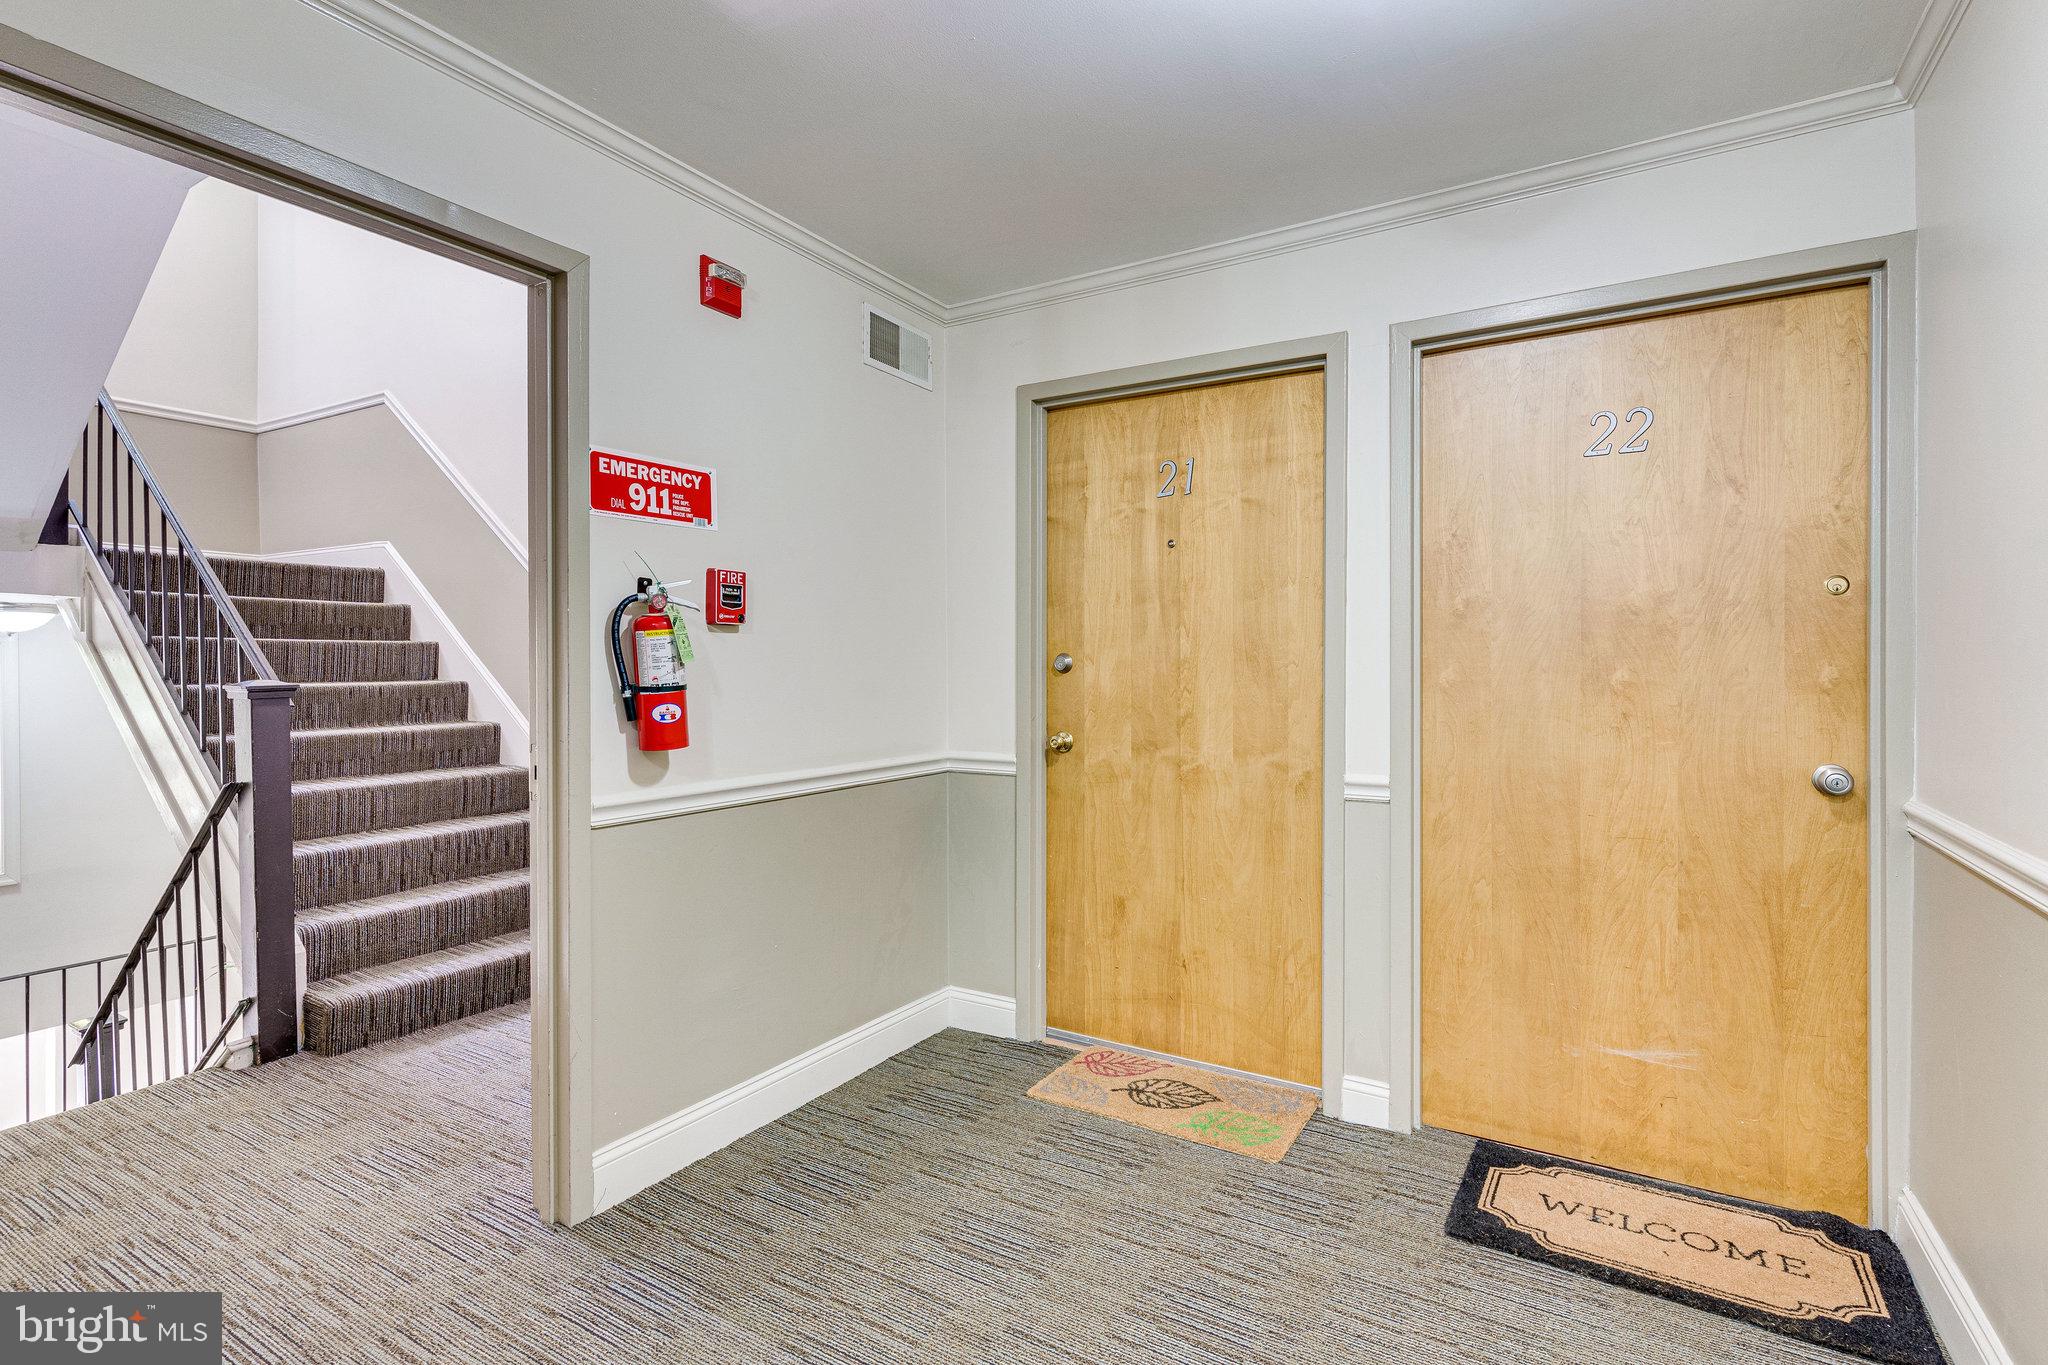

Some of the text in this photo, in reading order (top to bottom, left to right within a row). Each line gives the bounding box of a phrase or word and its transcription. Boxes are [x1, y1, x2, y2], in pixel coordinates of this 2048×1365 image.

[1583, 406, 1654, 457] 22
[598, 456, 702, 490] EMERGENCY
[1157, 457, 1195, 498] 21
[610, 497, 626, 510] DIAL
[628, 482, 672, 516] 911
[720, 571, 744, 584] FIRE
[1538, 1192, 1811, 1280] WELCOME
